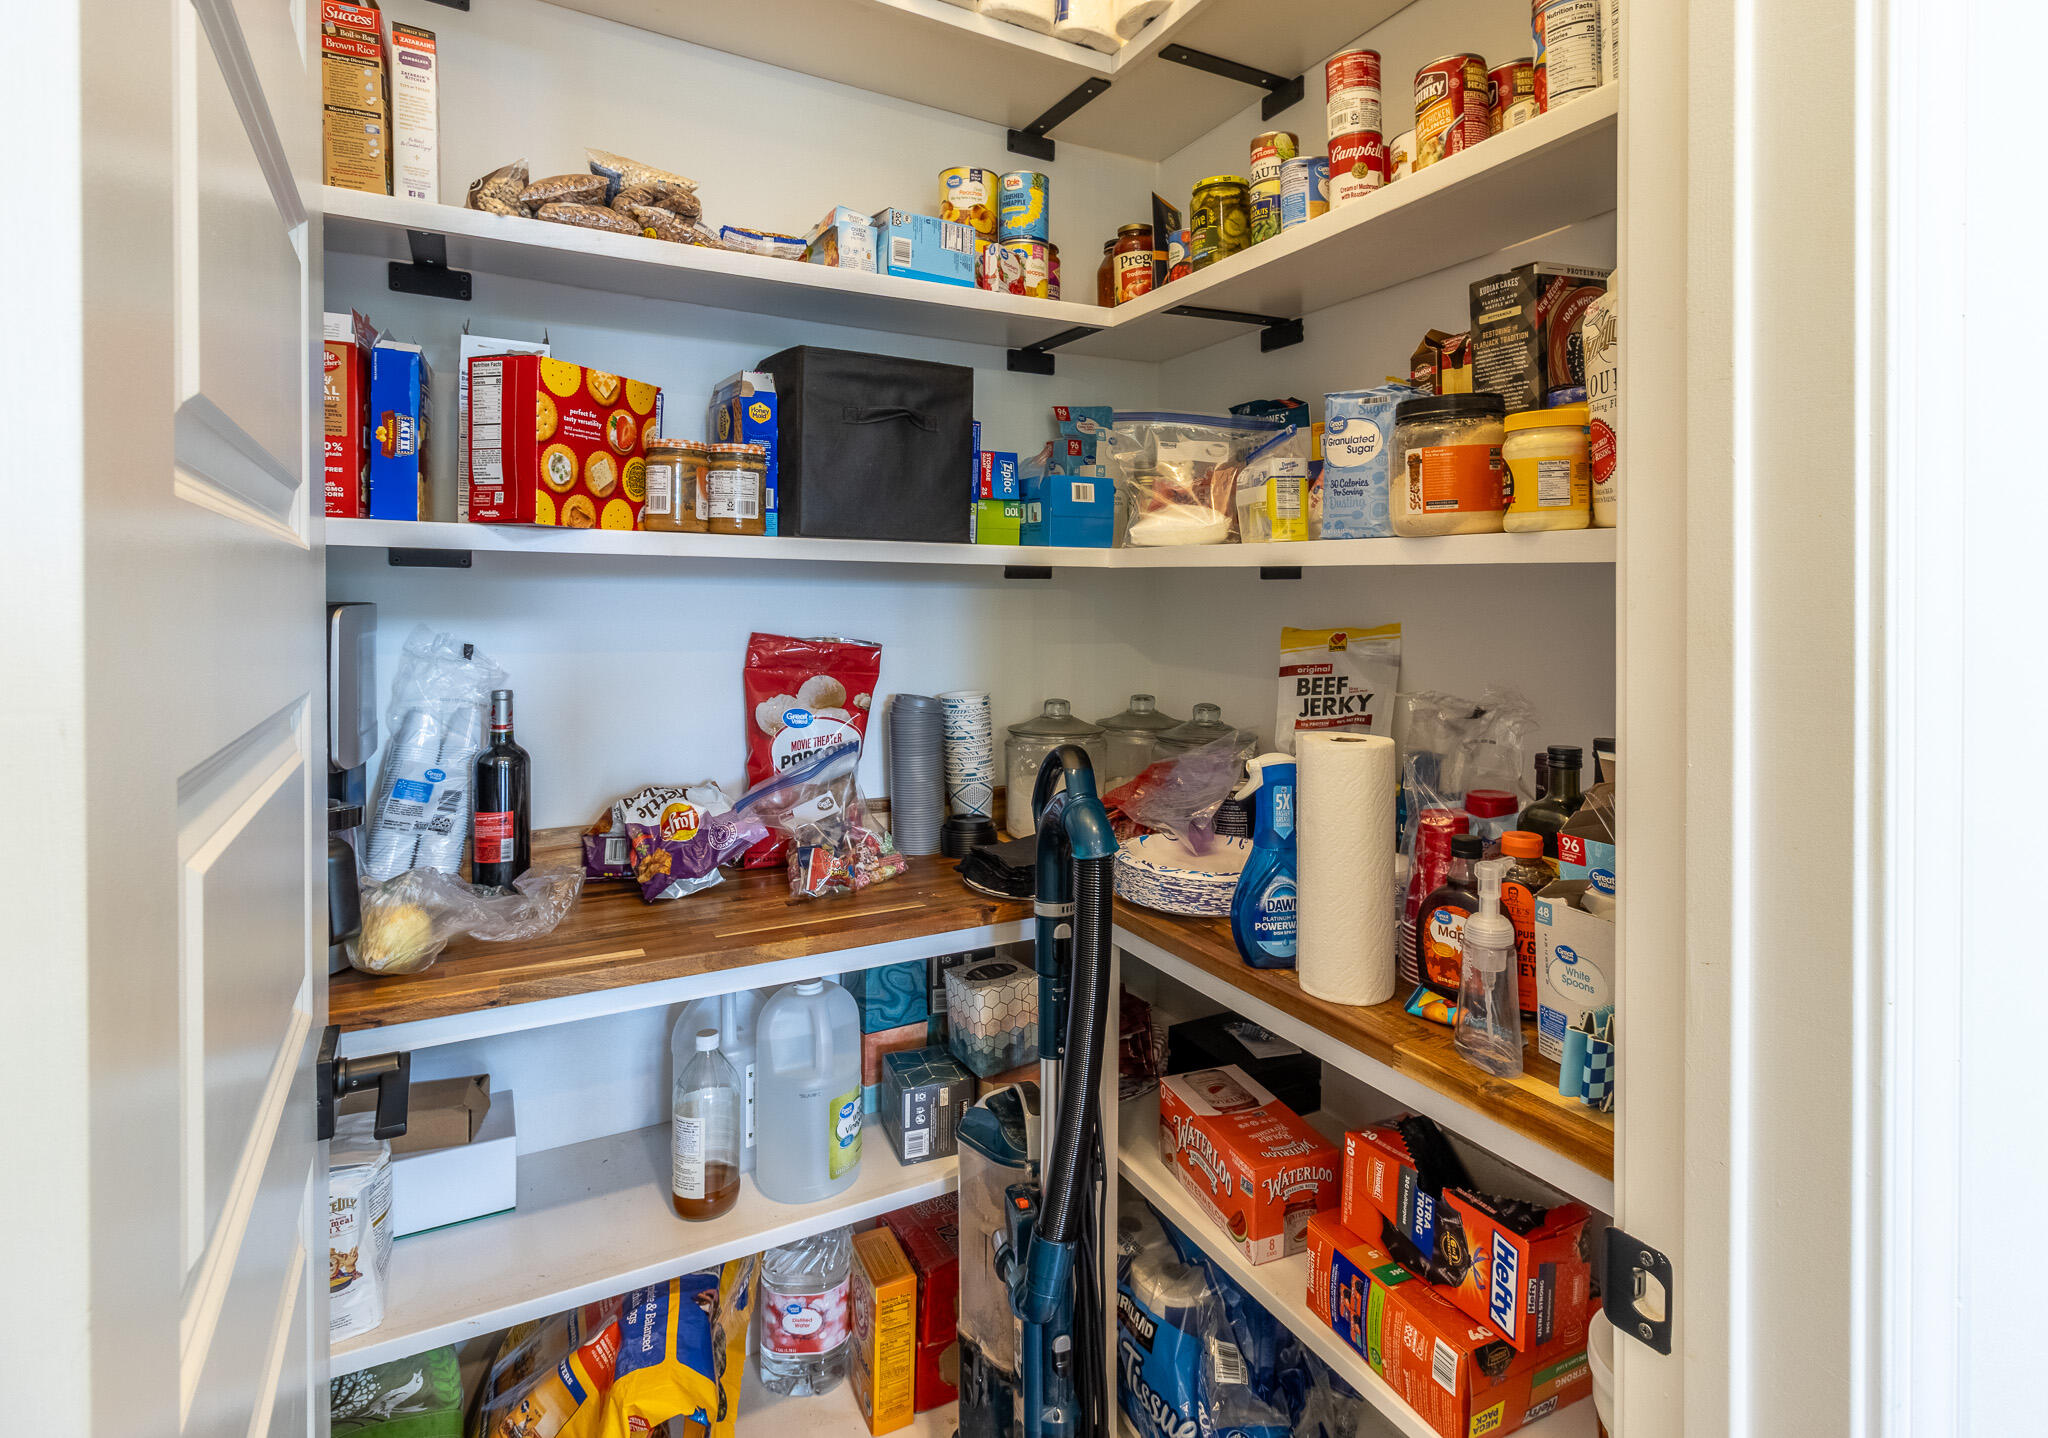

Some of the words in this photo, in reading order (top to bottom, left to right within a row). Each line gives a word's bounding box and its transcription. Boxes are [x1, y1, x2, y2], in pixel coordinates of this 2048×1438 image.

[325, 5, 372, 26] Success
[1547, 4, 1574, 21] Nutrition
[1575, 2, 1593, 10] Facts
[1548, 32, 1568, 44] Calories
[1586, 24, 1595, 32] 25
[326, 38, 355, 52] Brown
[357, 46, 376, 56] Rice
[1007, 179, 1020, 187] Dole
[1120, 253, 1152, 270] Preg
[1126, 270, 1152, 278] Traditiona
[1567, 268, 1611, 279] PROTEIN-PAC
[1480, 283, 1500, 297] KODIAK
[1537, 297, 1550, 314] NEW
[1546, 275, 1564, 300] RECIPES
[1562, 302, 1578, 323] 100%
[1500, 331, 1529, 345] TRADITION
[570, 409, 588, 418] perfect
[750, 406, 769, 415] Honey
[752, 411, 767, 420] Maid
[1057, 408, 1067, 416] 96
[400, 420, 410, 439] ACT
[564, 415, 576, 425] tasty
[576, 417, 602, 429] versatility
[401, 439, 410, 451] II
[1070, 441, 1079, 449] 96
[1328, 433, 1375, 447] Granulated
[1347, 445, 1375, 455] Sugar
[1001, 461, 1013, 494] Ziploc
[1330, 480, 1339, 489] 30
[1339, 479, 1370, 488] Calories
[981, 487, 988, 496] 25
[1341, 488, 1364, 497] Serving
[1005, 507, 1018, 517] 100
[1297, 664, 1331, 675] original
[1296, 676, 1349, 697] BEEF
[1299, 694, 1375, 718] JERKY
[786, 712, 809, 721] Great
[791, 738, 812, 753] MOVIE
[813, 733, 843, 748] THEATER
[1275, 793, 1291, 810] 5X
[663, 807, 699, 839] Lay's
[1561, 837, 1580, 853] 96
[1537, 906, 1550, 918] 48
[1438, 925, 1464, 942] Map
[1517, 930, 1536, 939] PUR
[1565, 965, 1591, 983] White
[1561, 974, 1595, 994] Spoons
[1361, 1130, 1378, 1141] 20
[1347, 1137, 1355, 1157] 20
[1173, 1115, 1233, 1197] WATERLOO
[1262, 1165, 1332, 1204] WATERLOO
[1416, 1191, 1425, 1235] TRONG
[1424, 1196, 1433, 1229] LTRA
[1269, 1238, 1275, 1250] 8
[1491, 1239, 1515, 1328] Hefty
[1528, 1280, 1537, 1313] Hefty
[641, 1312, 657, 1352] Balanced
[1468, 1325, 1494, 1341] 40
[1555, 1366, 1588, 1389] STRONG
[1122, 1340, 1198, 1438] Tissue
[1476, 1407, 1499, 1425] PACK
[1526, 1398, 1558, 1420] Hefty
[1473, 1417, 1498, 1435] MEGA
